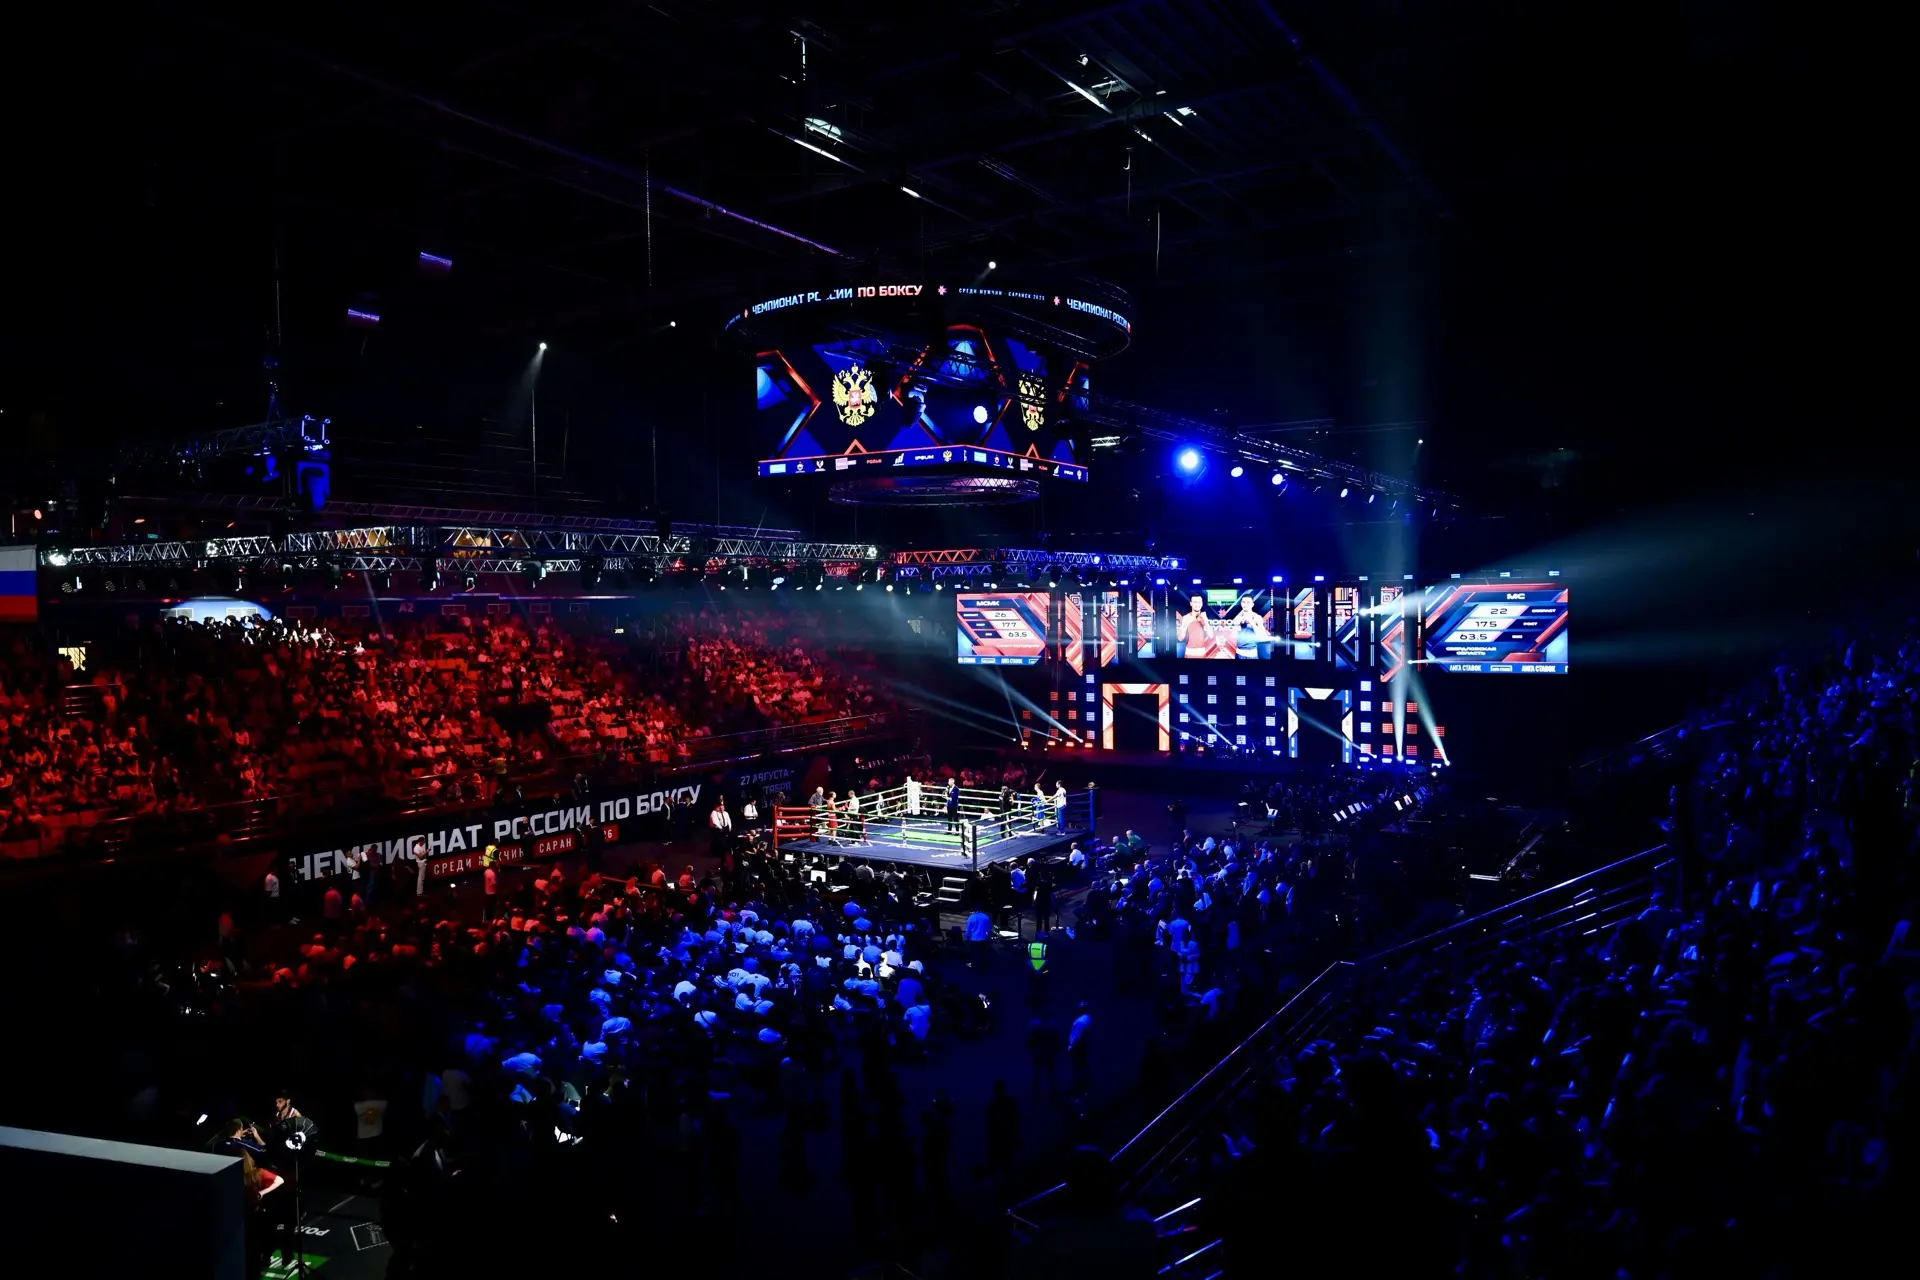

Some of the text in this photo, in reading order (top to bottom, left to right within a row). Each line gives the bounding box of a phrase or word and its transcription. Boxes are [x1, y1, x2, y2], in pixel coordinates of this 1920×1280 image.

[752, 294, 804, 314] ЧЕМПИОНАТ
[857, 286, 876, 298] ПО
[879, 285, 923, 297] БОКСУ
[1066, 298, 1112, 319] ЧЕМПИОНАТ
[1459, 633, 1488, 641] 63.5
[600, 797, 630, 823] ПО
[433, 857, 472, 875] СРЕДИ
